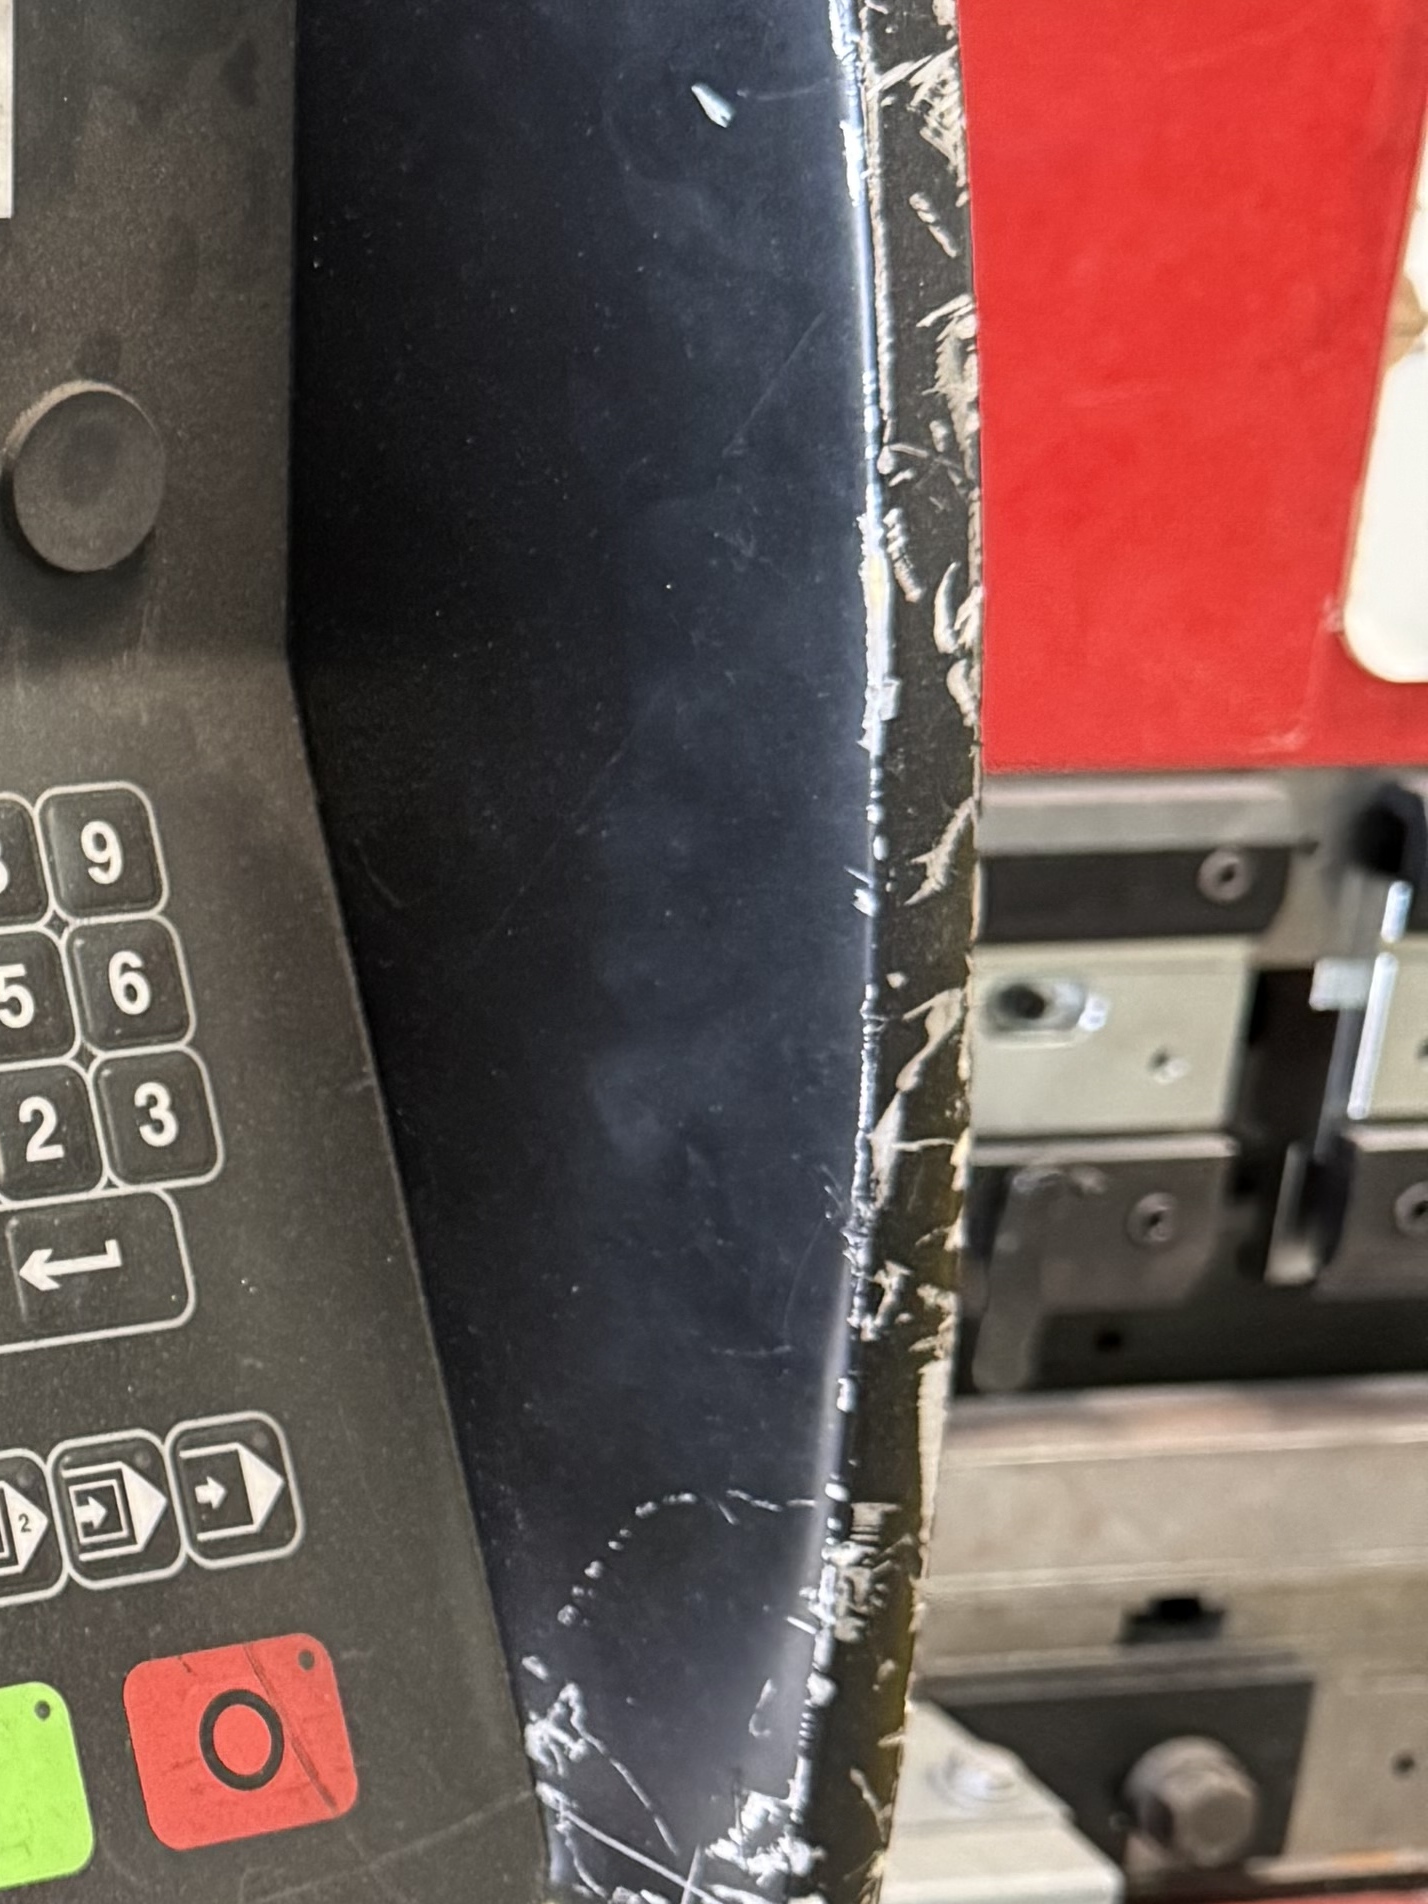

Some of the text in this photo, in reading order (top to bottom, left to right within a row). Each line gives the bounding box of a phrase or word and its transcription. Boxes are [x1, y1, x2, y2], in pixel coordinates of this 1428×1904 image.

[80, 820, 124, 885] 9
[107, 950, 152, 1016] 6
[18, 1096, 66, 1163] 2
[134, 1082, 180, 1148] 3
[17, 1513, 33, 1534] 2
